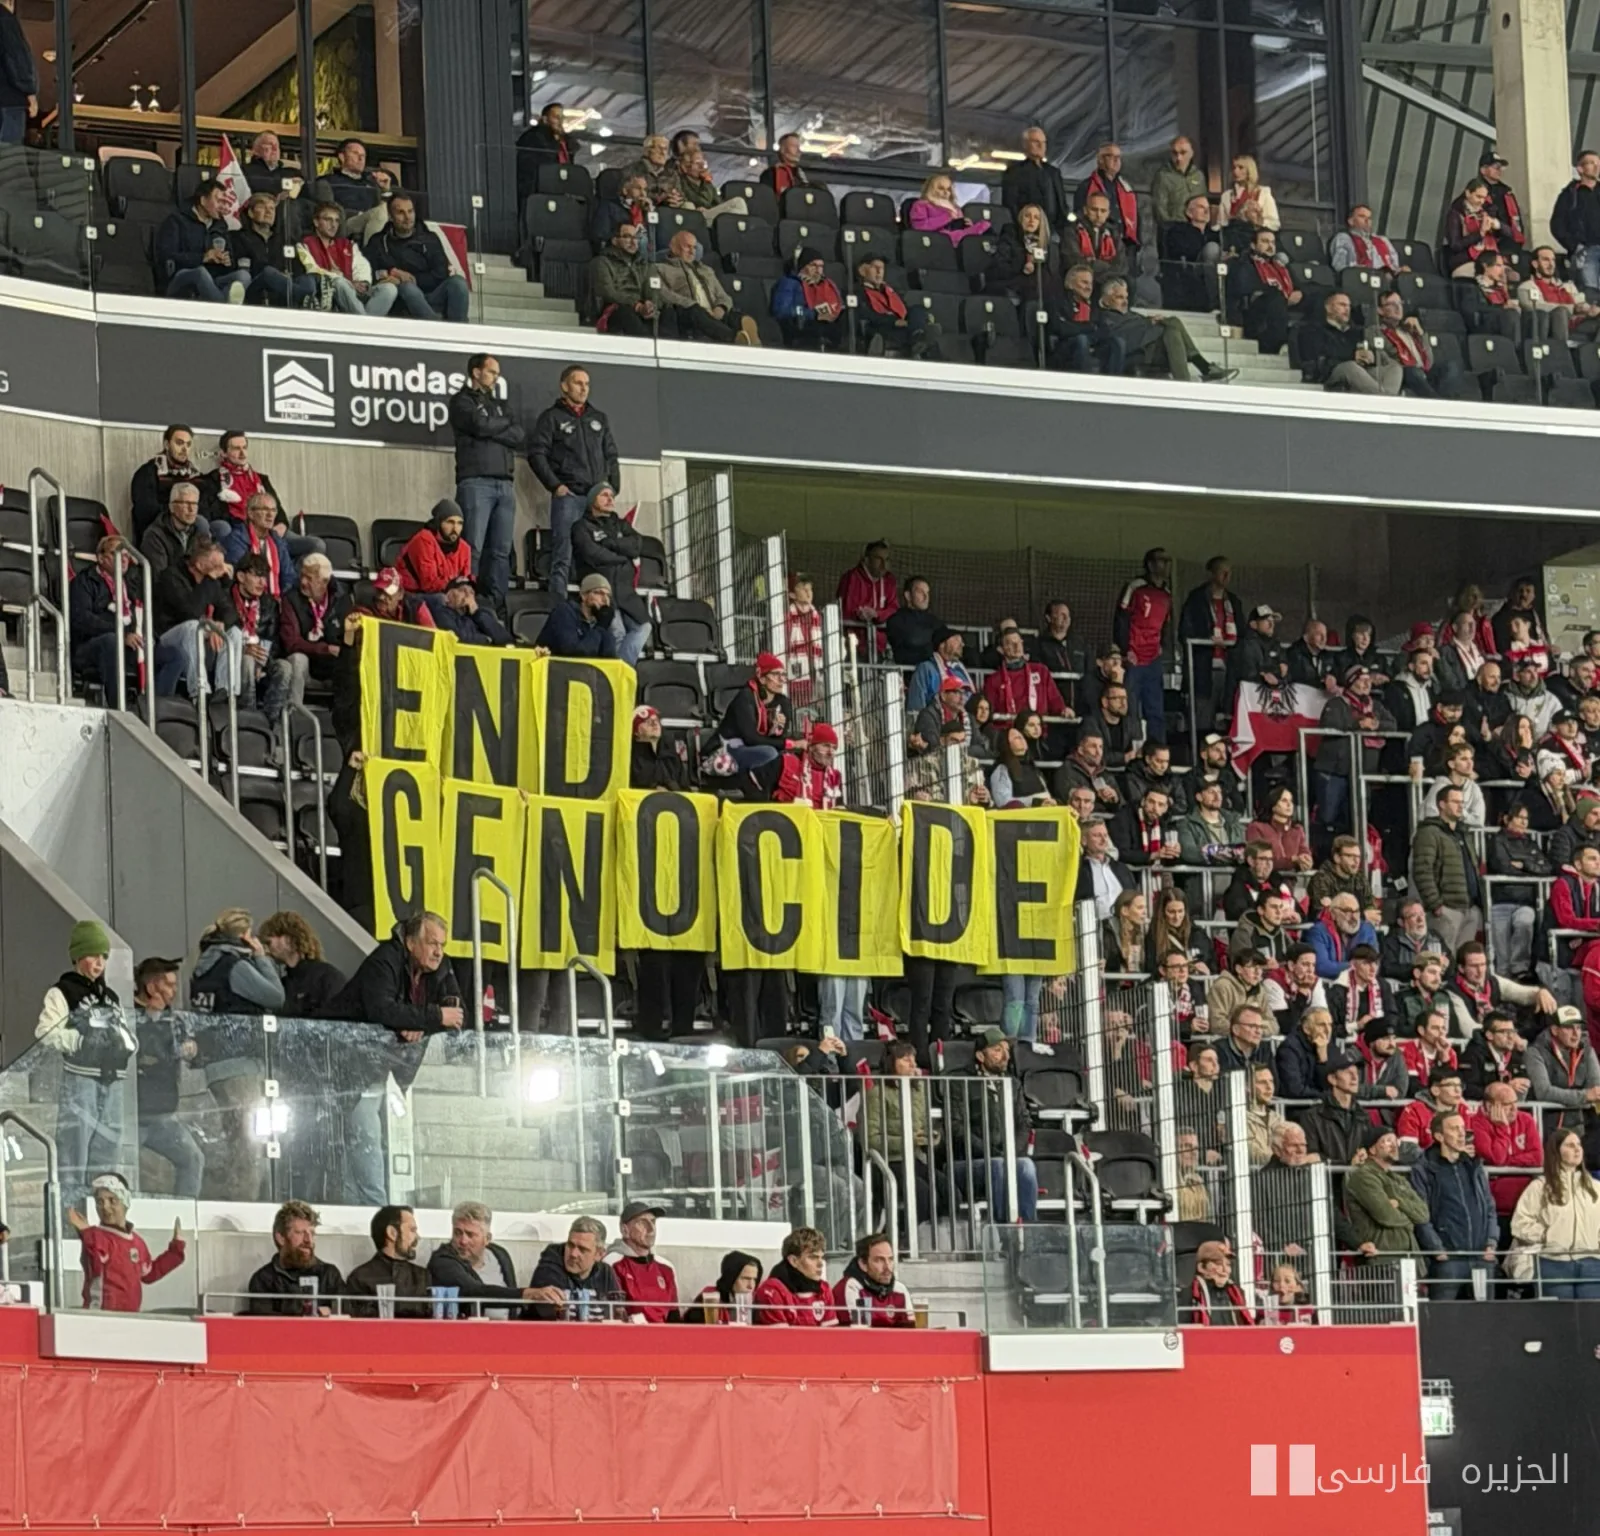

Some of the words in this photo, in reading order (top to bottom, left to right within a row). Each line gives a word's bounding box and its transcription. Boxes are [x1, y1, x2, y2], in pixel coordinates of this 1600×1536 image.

[349, 362, 508, 400] umdas
[350, 395, 449, 432] group
[378, 621, 616, 799] END
[381, 768, 1057, 960] GENOCIDE
